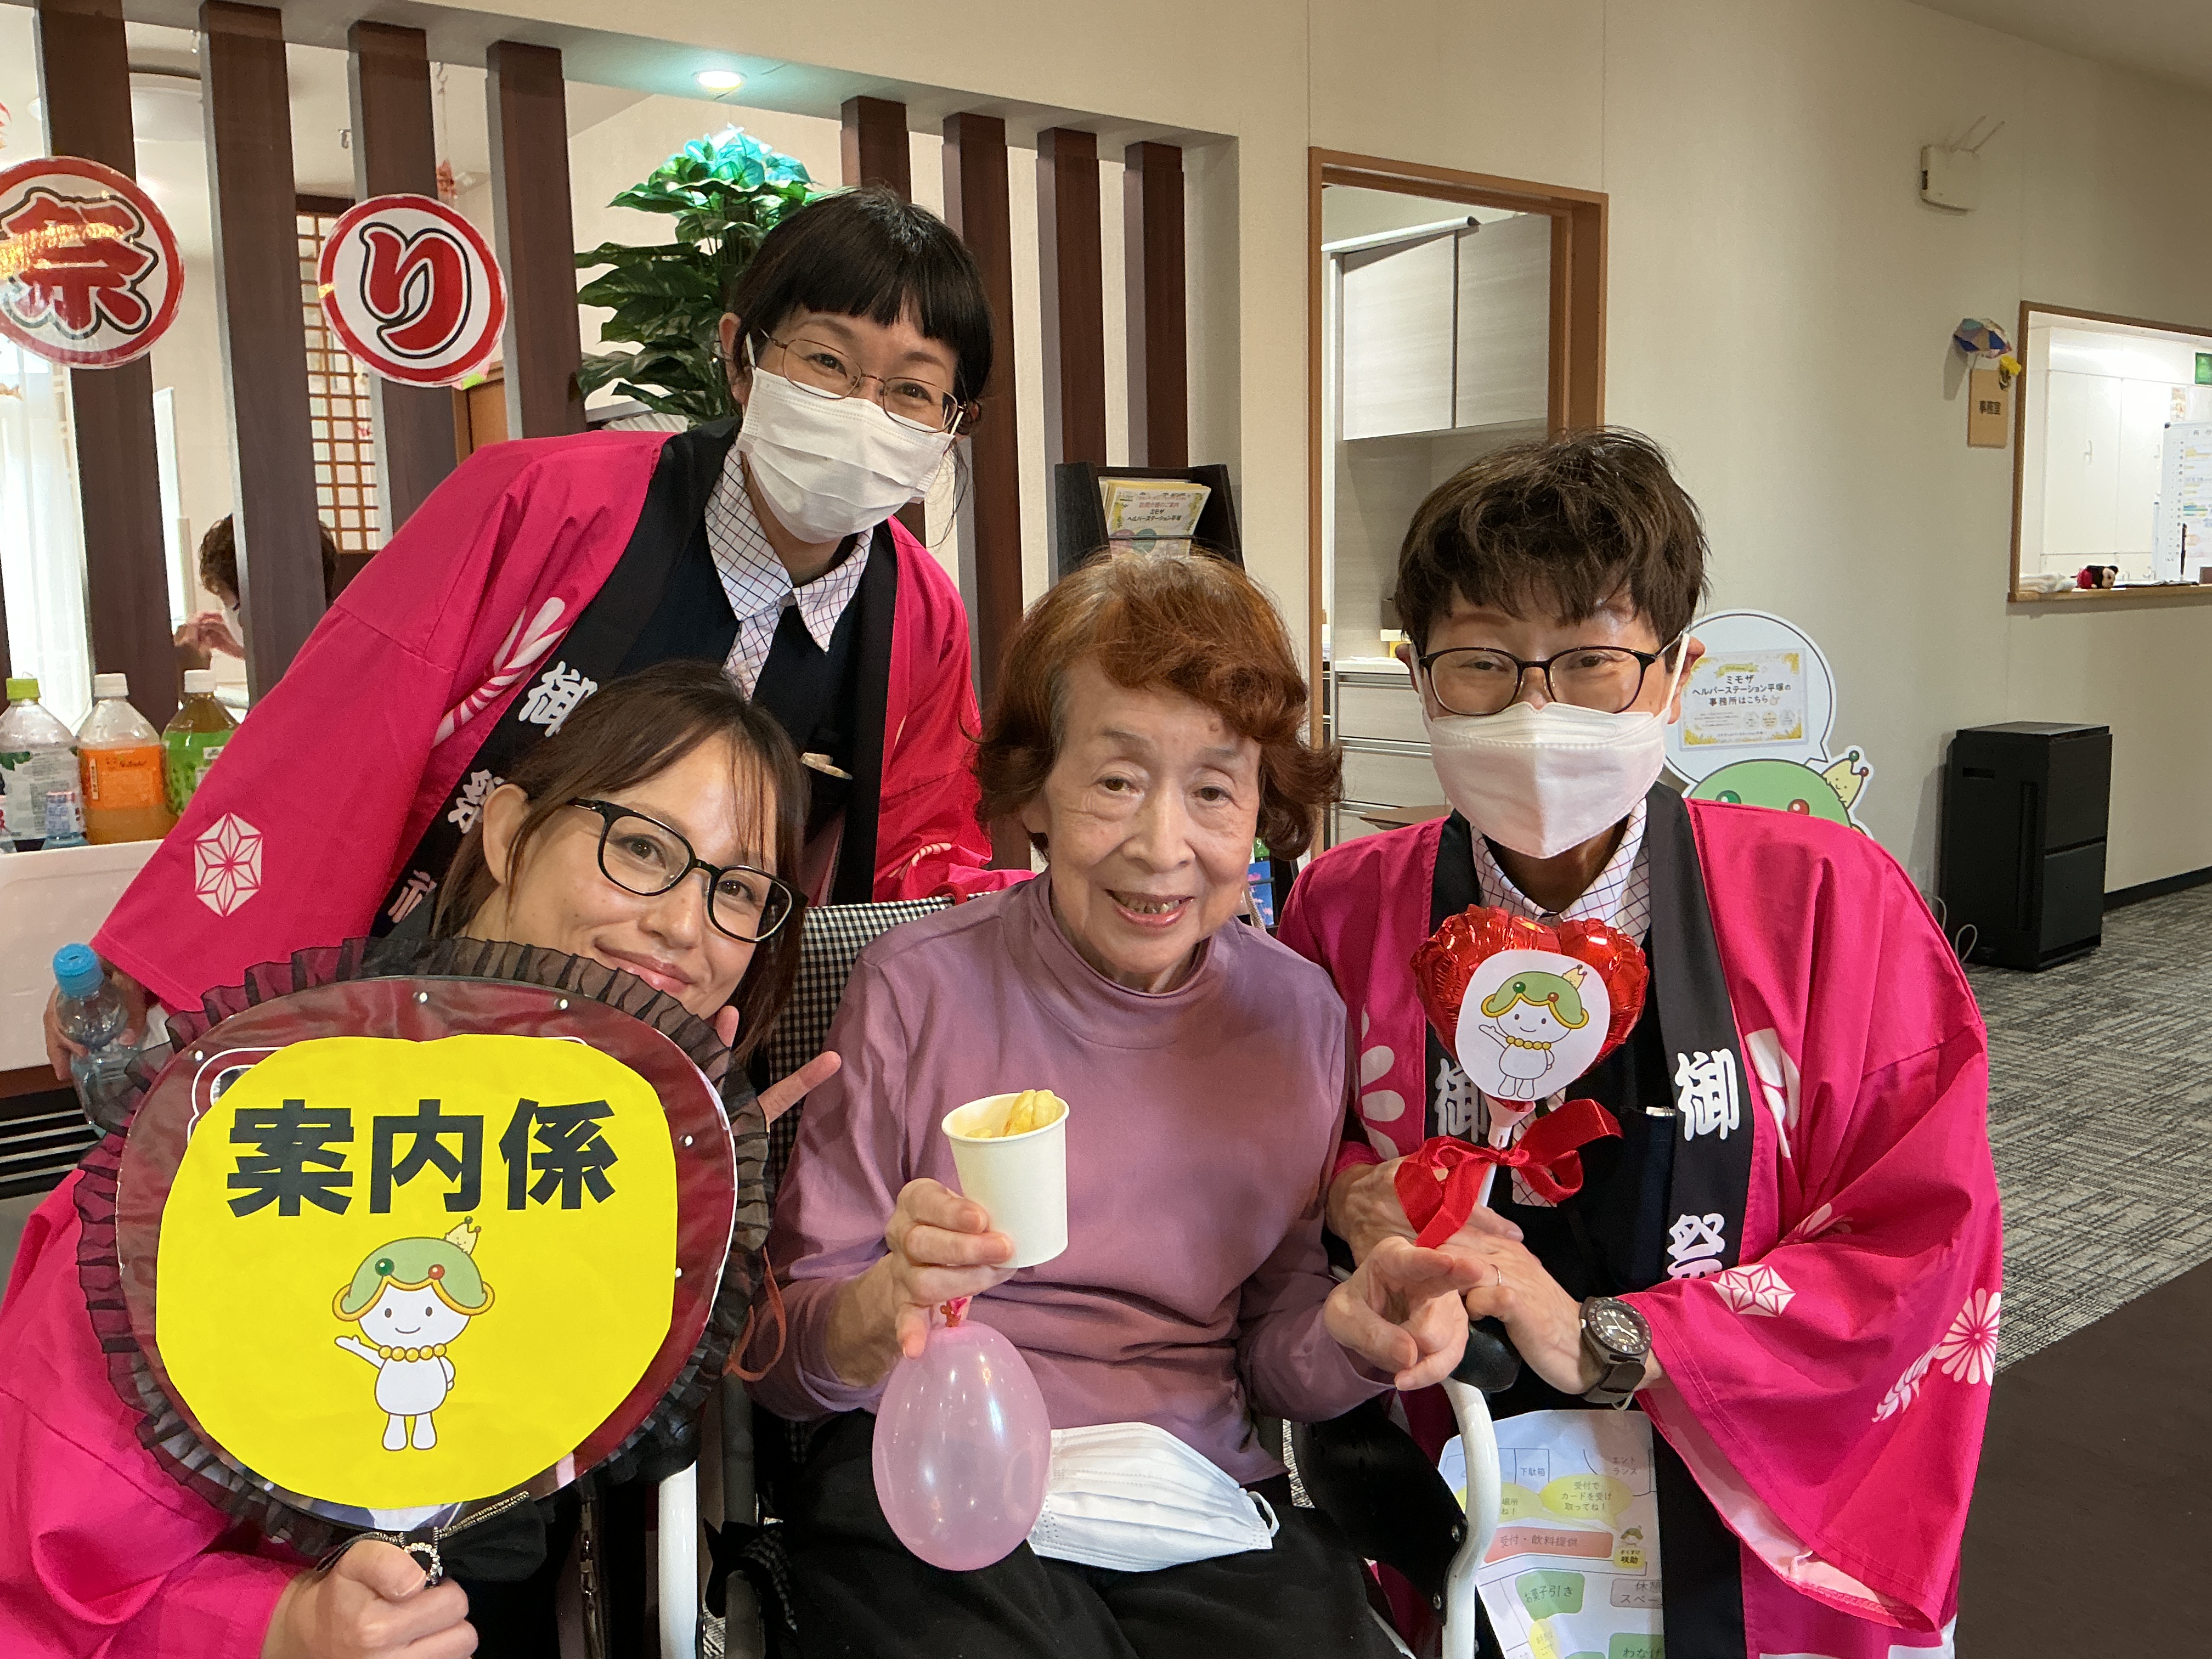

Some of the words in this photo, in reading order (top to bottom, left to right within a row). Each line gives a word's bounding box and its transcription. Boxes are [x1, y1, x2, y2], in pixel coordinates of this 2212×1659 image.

[359, 222, 473, 359] り
[1726, 674, 1754, 684] ミモザ
[1692, 682, 1791, 695] ヘルパーステーション平塚の
[1708, 695, 1768, 707] 事務所はこちら
[227, 1097, 619, 1218] 案内係
[1612, 1456, 1636, 1465] エント
[1520, 1467, 1545, 1476] 下駄箱
[1613, 1467, 1638, 1476] ランス
[1573, 1481, 1600, 1490] 受付で
[1561, 1492, 1612, 1502] カードを受け
[1499, 1534, 1578, 1548] 受付・飲料提供
